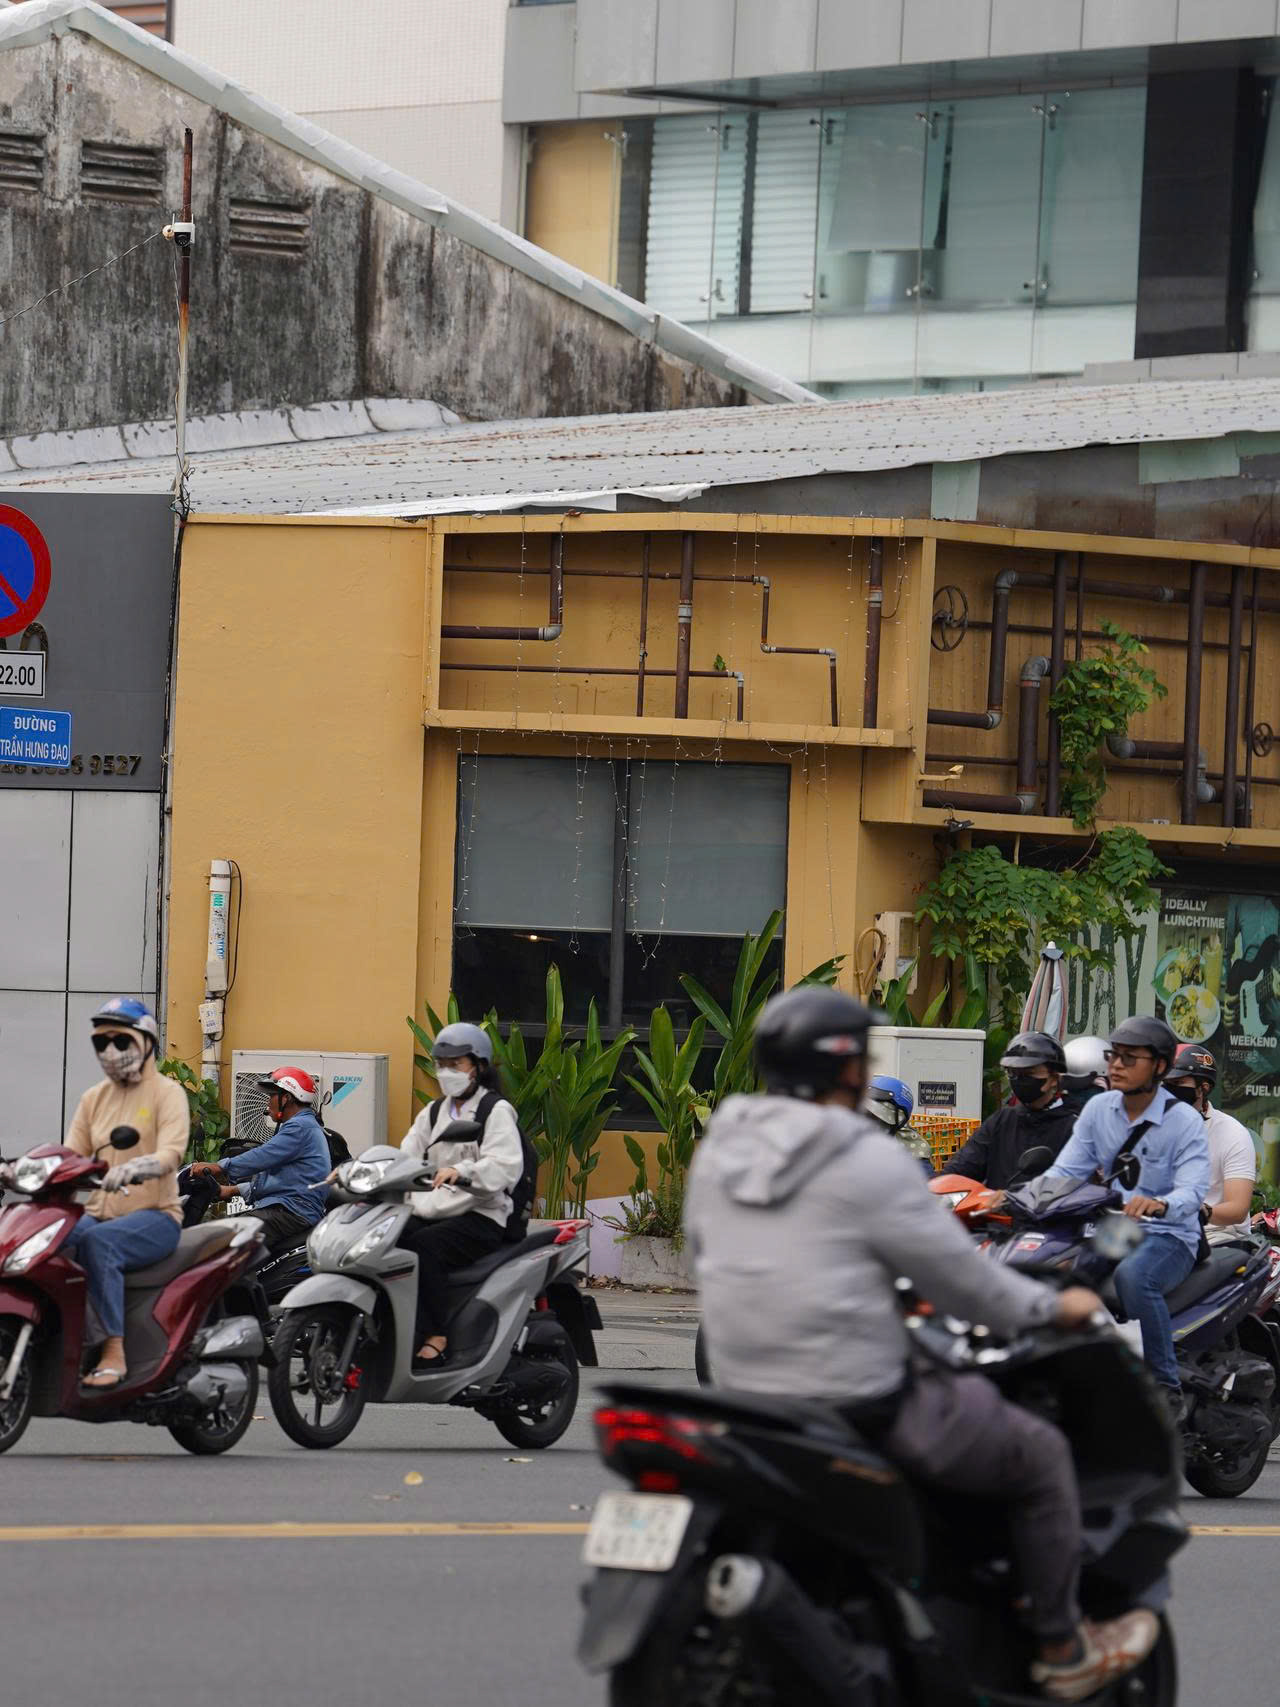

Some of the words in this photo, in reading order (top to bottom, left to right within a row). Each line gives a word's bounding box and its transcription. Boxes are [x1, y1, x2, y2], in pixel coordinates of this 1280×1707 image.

[13, 714, 57, 732] ĐƯỜNG
[0, 735, 23, 757] TRẦN
[25, 740, 49, 759] HƯNG
[50, 743, 68, 764] ĐẠO
[90, 754, 142, 777] 9527
[1165, 898, 1207, 912] IDEALLY
[1164, 914, 1225, 929] LUNCHTIME
[1229, 1034, 1278, 1048] WEEKEND
[1245, 1084, 1271, 1097] FUEL
